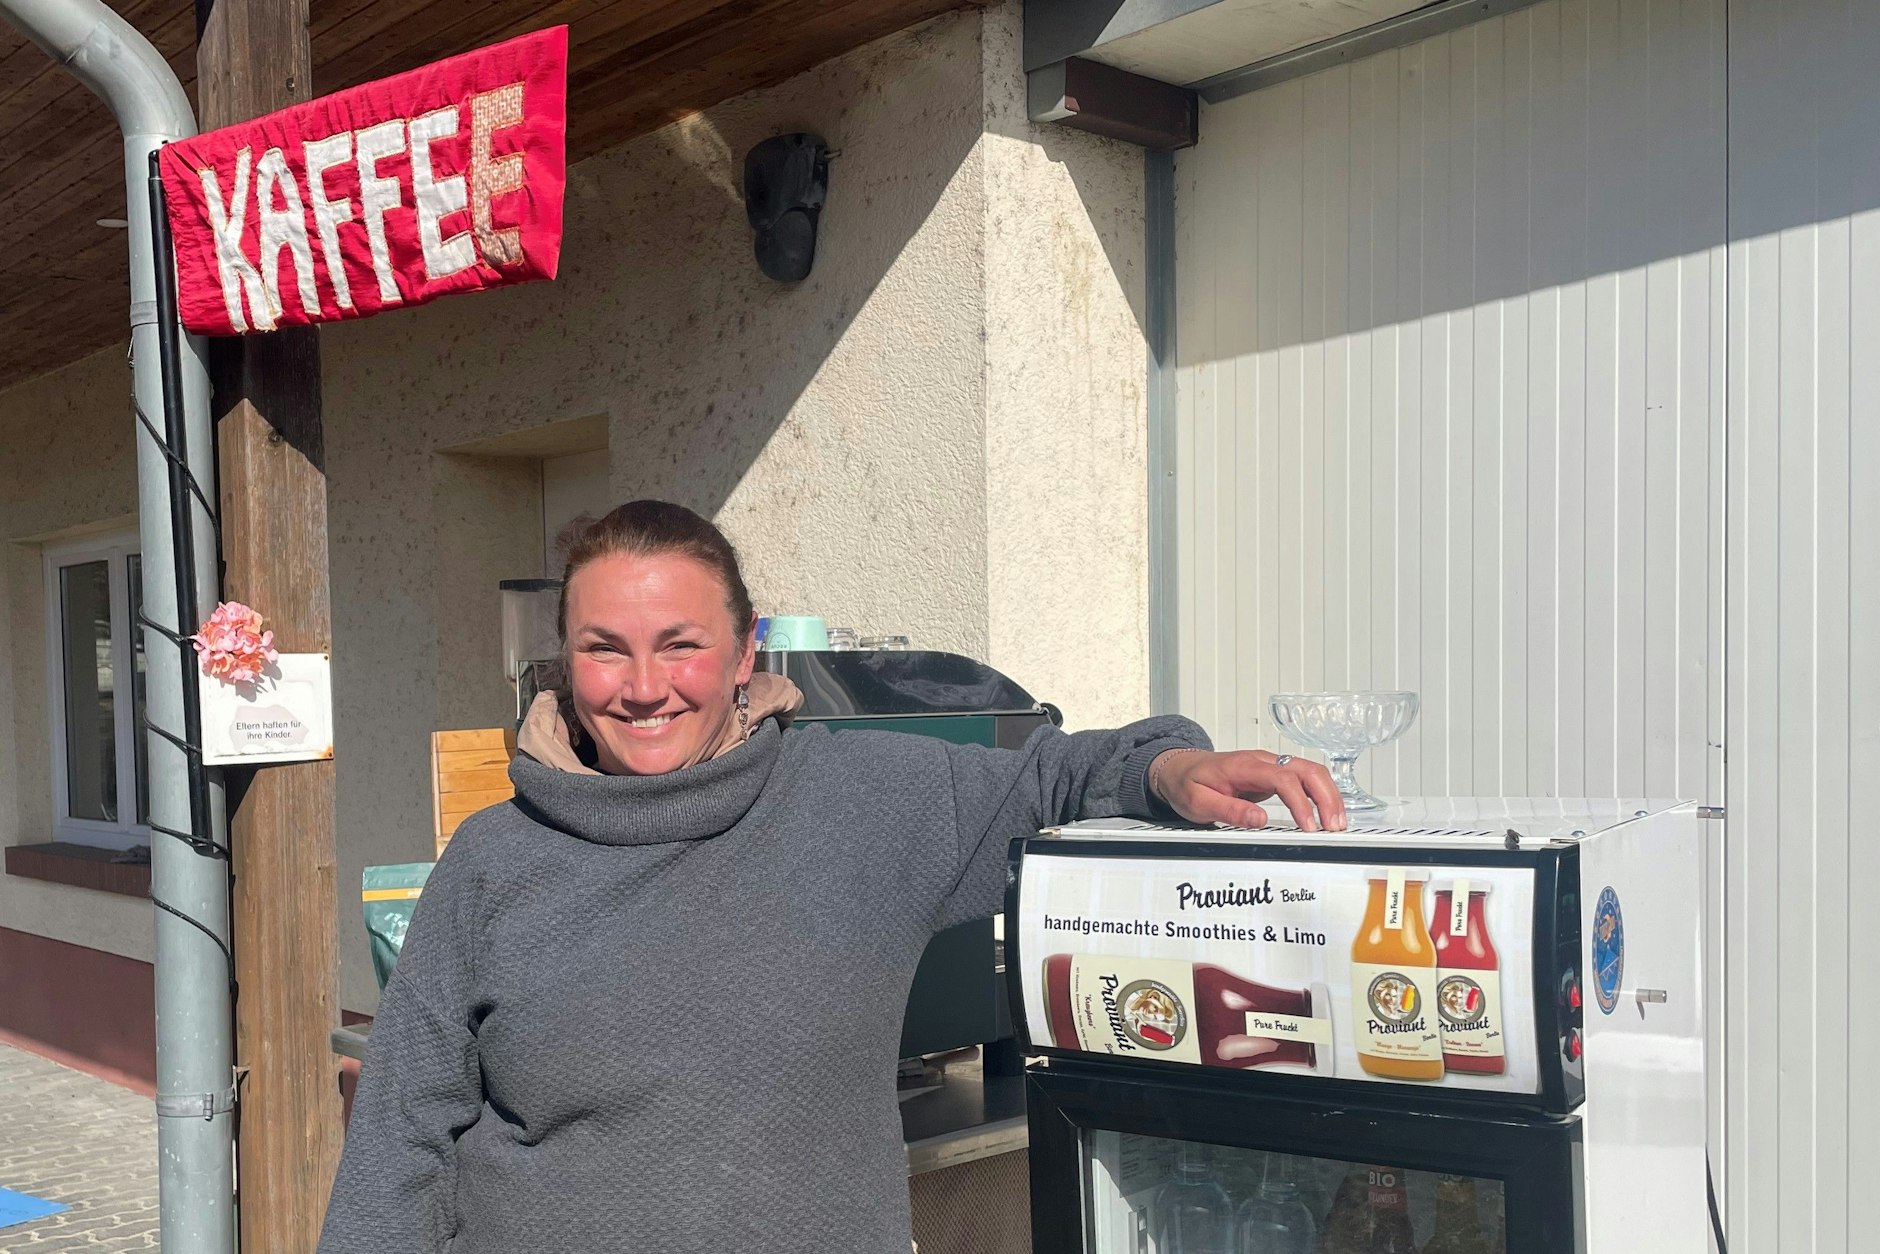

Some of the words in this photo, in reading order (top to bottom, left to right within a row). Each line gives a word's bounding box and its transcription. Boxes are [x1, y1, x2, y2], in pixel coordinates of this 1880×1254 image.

[198, 81, 525, 333] KAFFEE
[236, 722, 260, 730] Eltern
[262, 721, 288, 729] haften
[290, 720, 302, 728] für
[247, 732, 262, 740] ihre
[1176, 879, 1274, 910] Proviant
[1280, 889, 1316, 902] Berlin
[1044, 915, 1159, 936] handgemachte
[1165, 921, 1256, 942] Smoothies
[1263, 926, 1277, 942] &
[1284, 927, 1326, 946] Limo
[1099, 974, 1136, 1052] Proviant
[1254, 1019, 1273, 1030] Pure
[1366, 1017, 1426, 1034] Proviant
[1368, 1171, 1396, 1187] BIO
